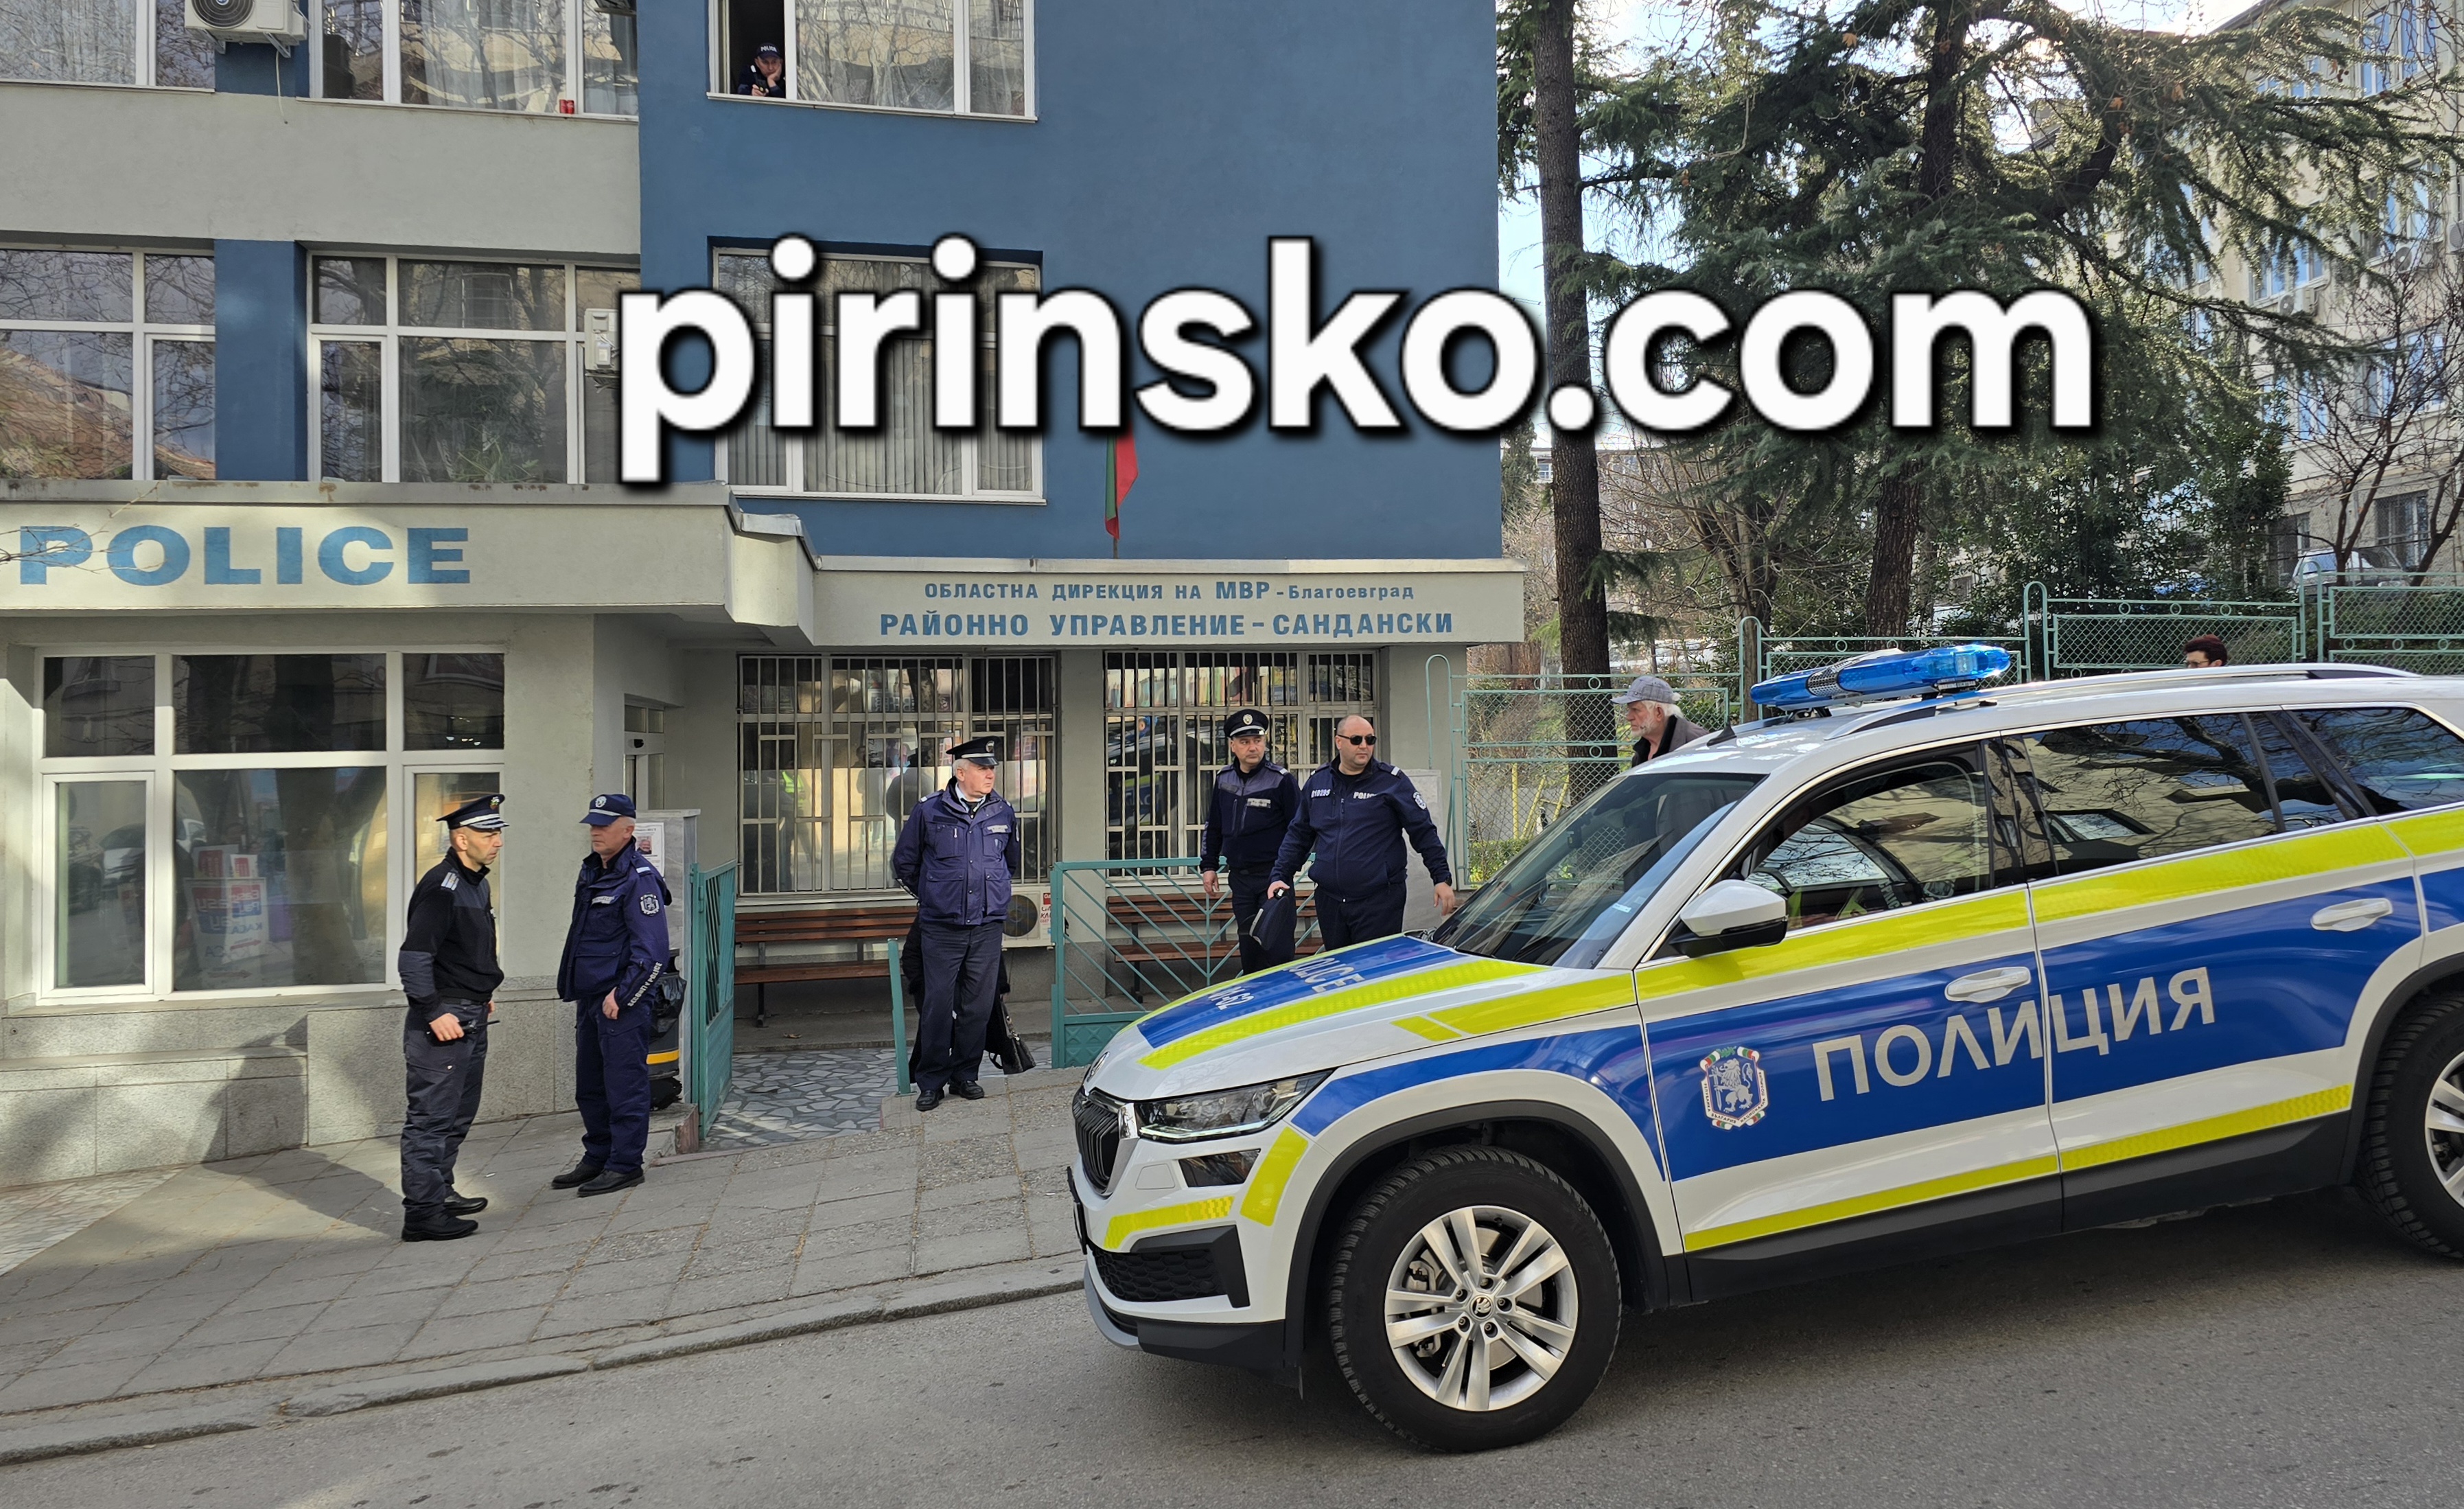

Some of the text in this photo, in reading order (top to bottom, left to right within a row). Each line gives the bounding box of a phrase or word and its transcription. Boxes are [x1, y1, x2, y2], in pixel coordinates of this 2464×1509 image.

[20, 525, 471, 586] POLICE
[925, 583, 1038, 599] ОБЛАСТНА
[1052, 584, 1163, 601] ДИРЕКЦИЯ
[1175, 585, 1201, 599] НА
[1216, 581, 1270, 599] МВР
[1288, 586, 1414, 601] Благоевград
[880, 610, 1029, 636] РАЙОННО
[1049, 614, 1245, 636] УПРАВЛЕНИЕ
[1272, 613, 1453, 638] САНДАНСКИ
[1353, 792, 1378, 800] POLI
[1283, 958, 1366, 993] OLICE
[1812, 967, 2216, 1102] ПОЛИЦИЯ
